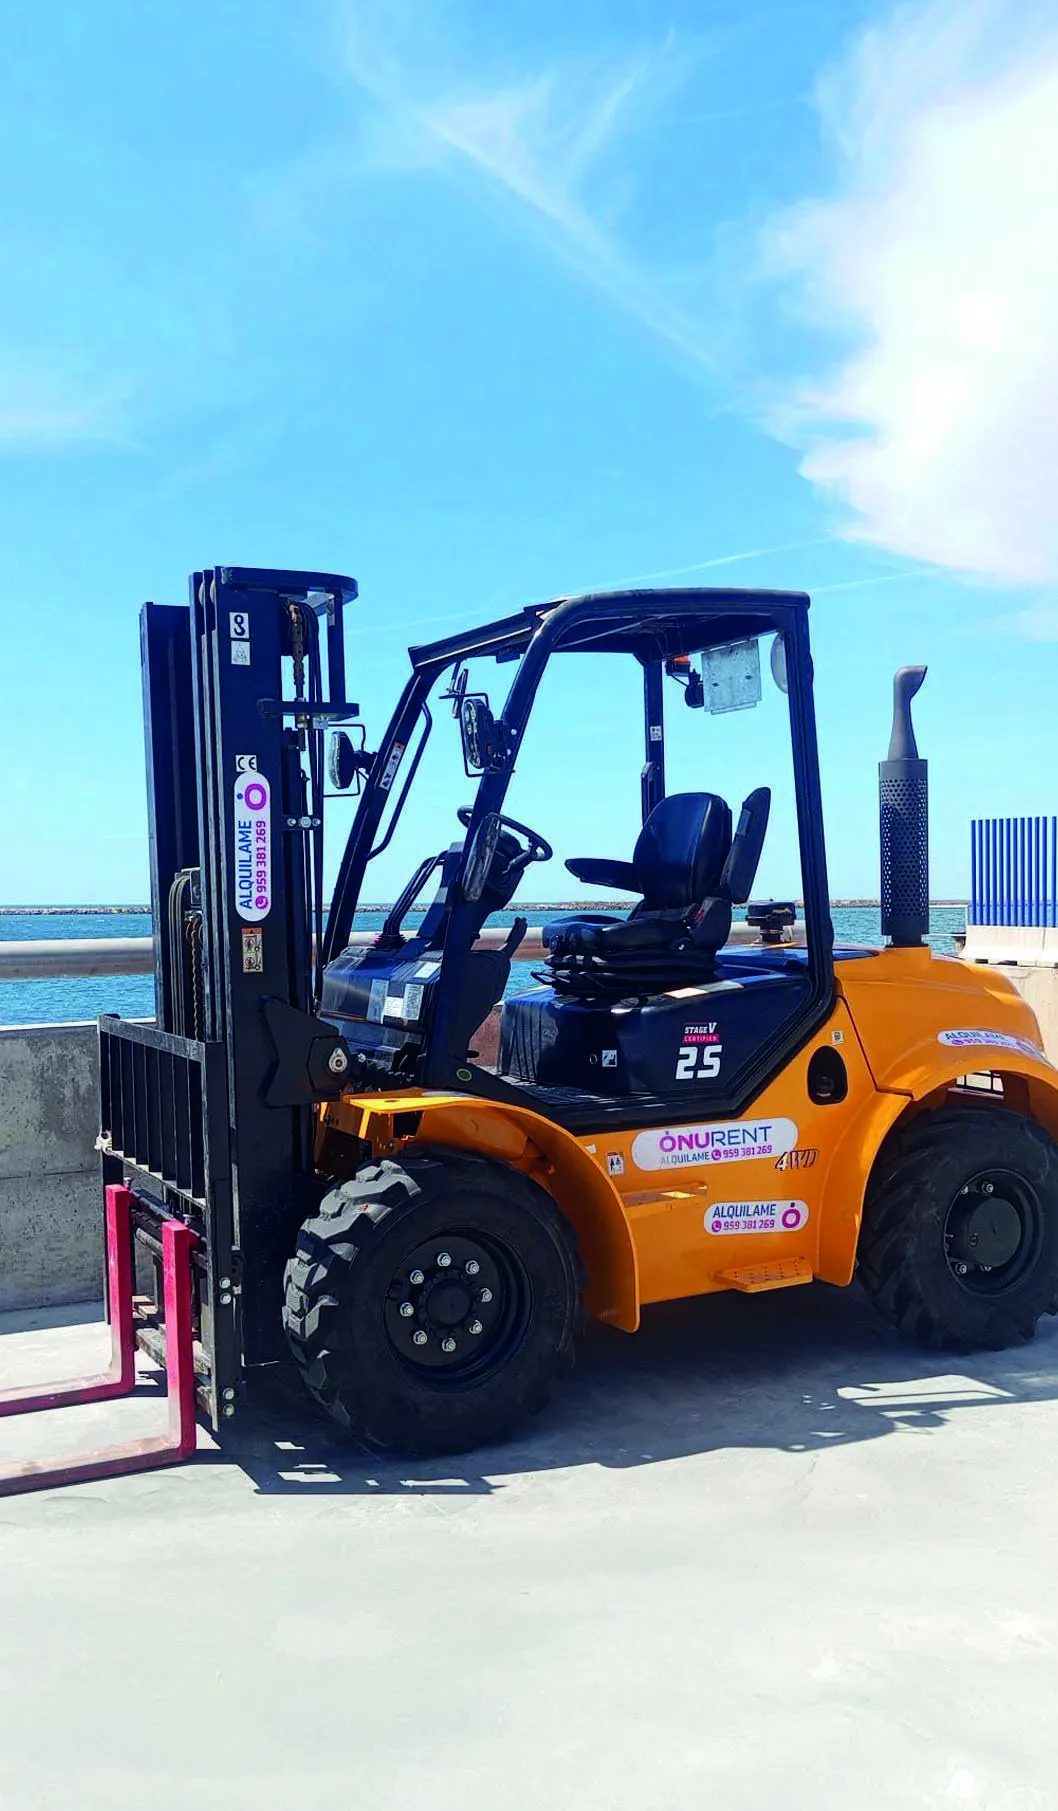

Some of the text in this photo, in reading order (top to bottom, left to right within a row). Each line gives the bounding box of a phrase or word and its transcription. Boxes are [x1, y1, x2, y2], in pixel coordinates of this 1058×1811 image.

[237, 757, 257, 770] CE
[239, 820, 254, 910] ALQUILAME
[256, 820, 267, 893] 959 381 269
[684, 1026, 708, 1034] STAGE
[675, 1045, 722, 1080] 25
[661, 1145, 773, 1165] ALQUILAME 959 381 269
[712, 1204, 777, 1219] ALQUILAME
[723, 1219, 775, 1230] 959 381 269
